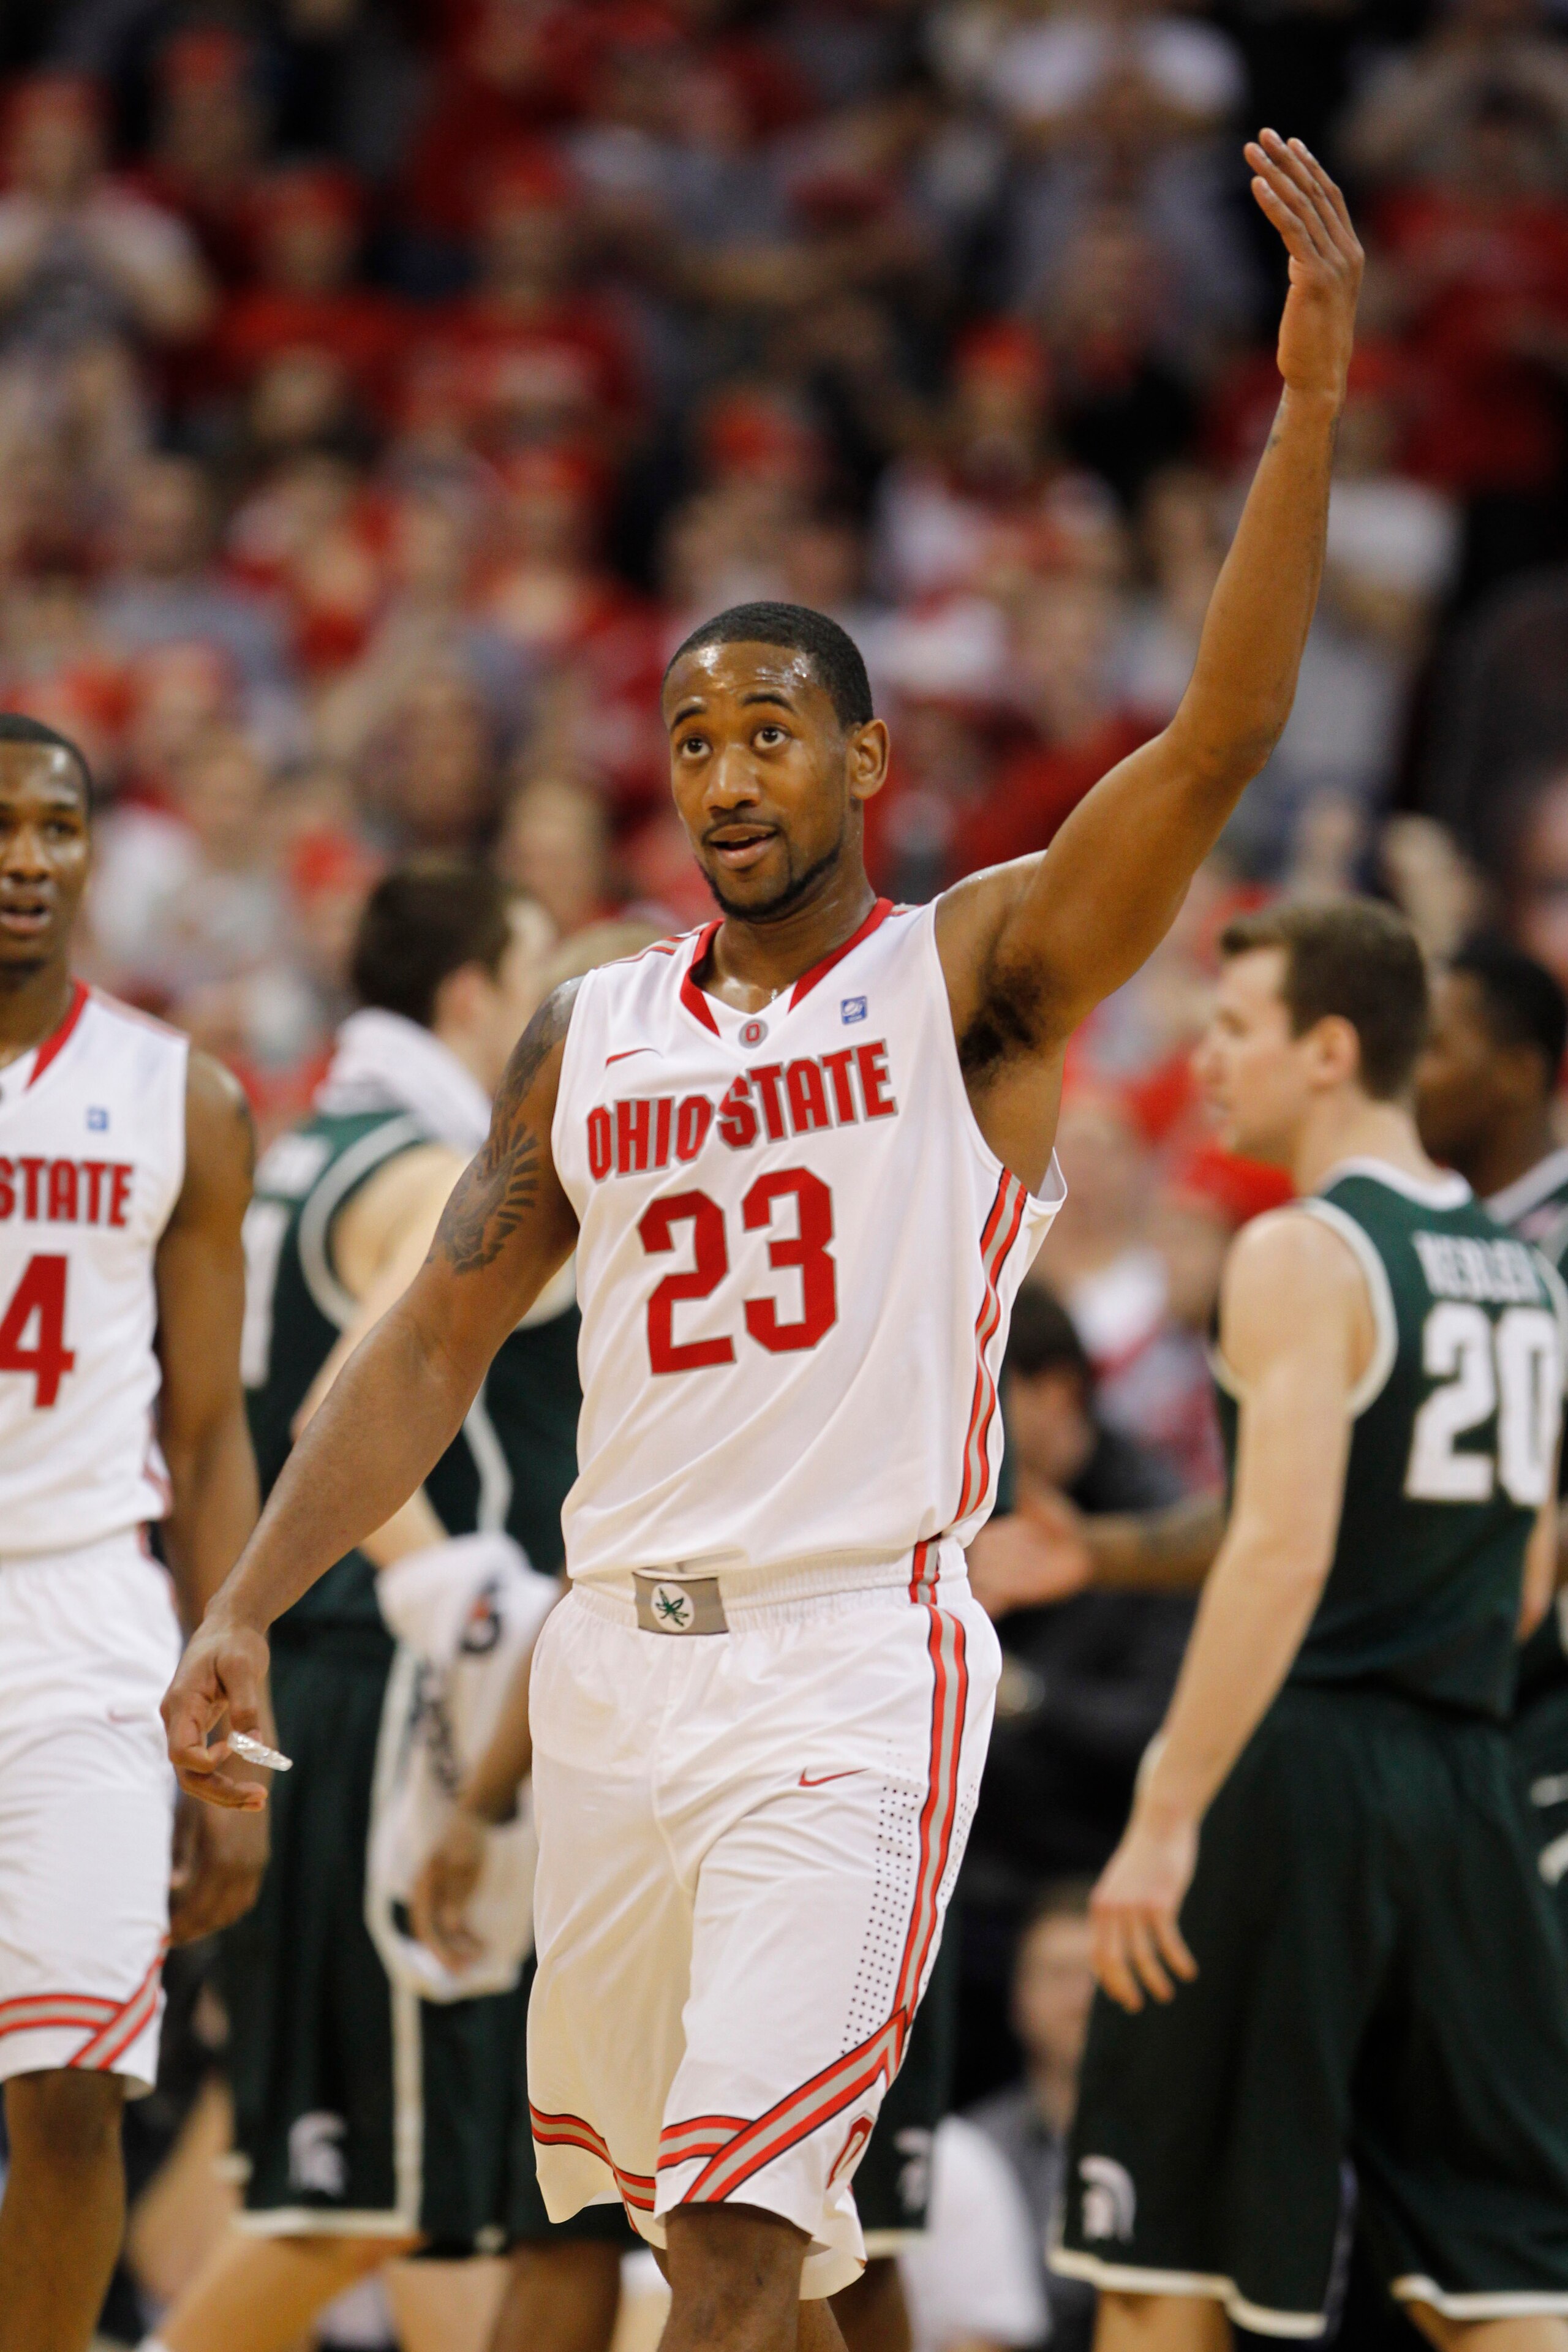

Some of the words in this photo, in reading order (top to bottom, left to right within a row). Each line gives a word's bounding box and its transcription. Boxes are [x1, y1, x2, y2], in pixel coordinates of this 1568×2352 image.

[587, 1094, 715, 1184] OHIO
[717, 1038, 899, 1152] STATE
[636, 1166, 839, 1377] 23
[1403, 1298, 1562, 1506] 20
